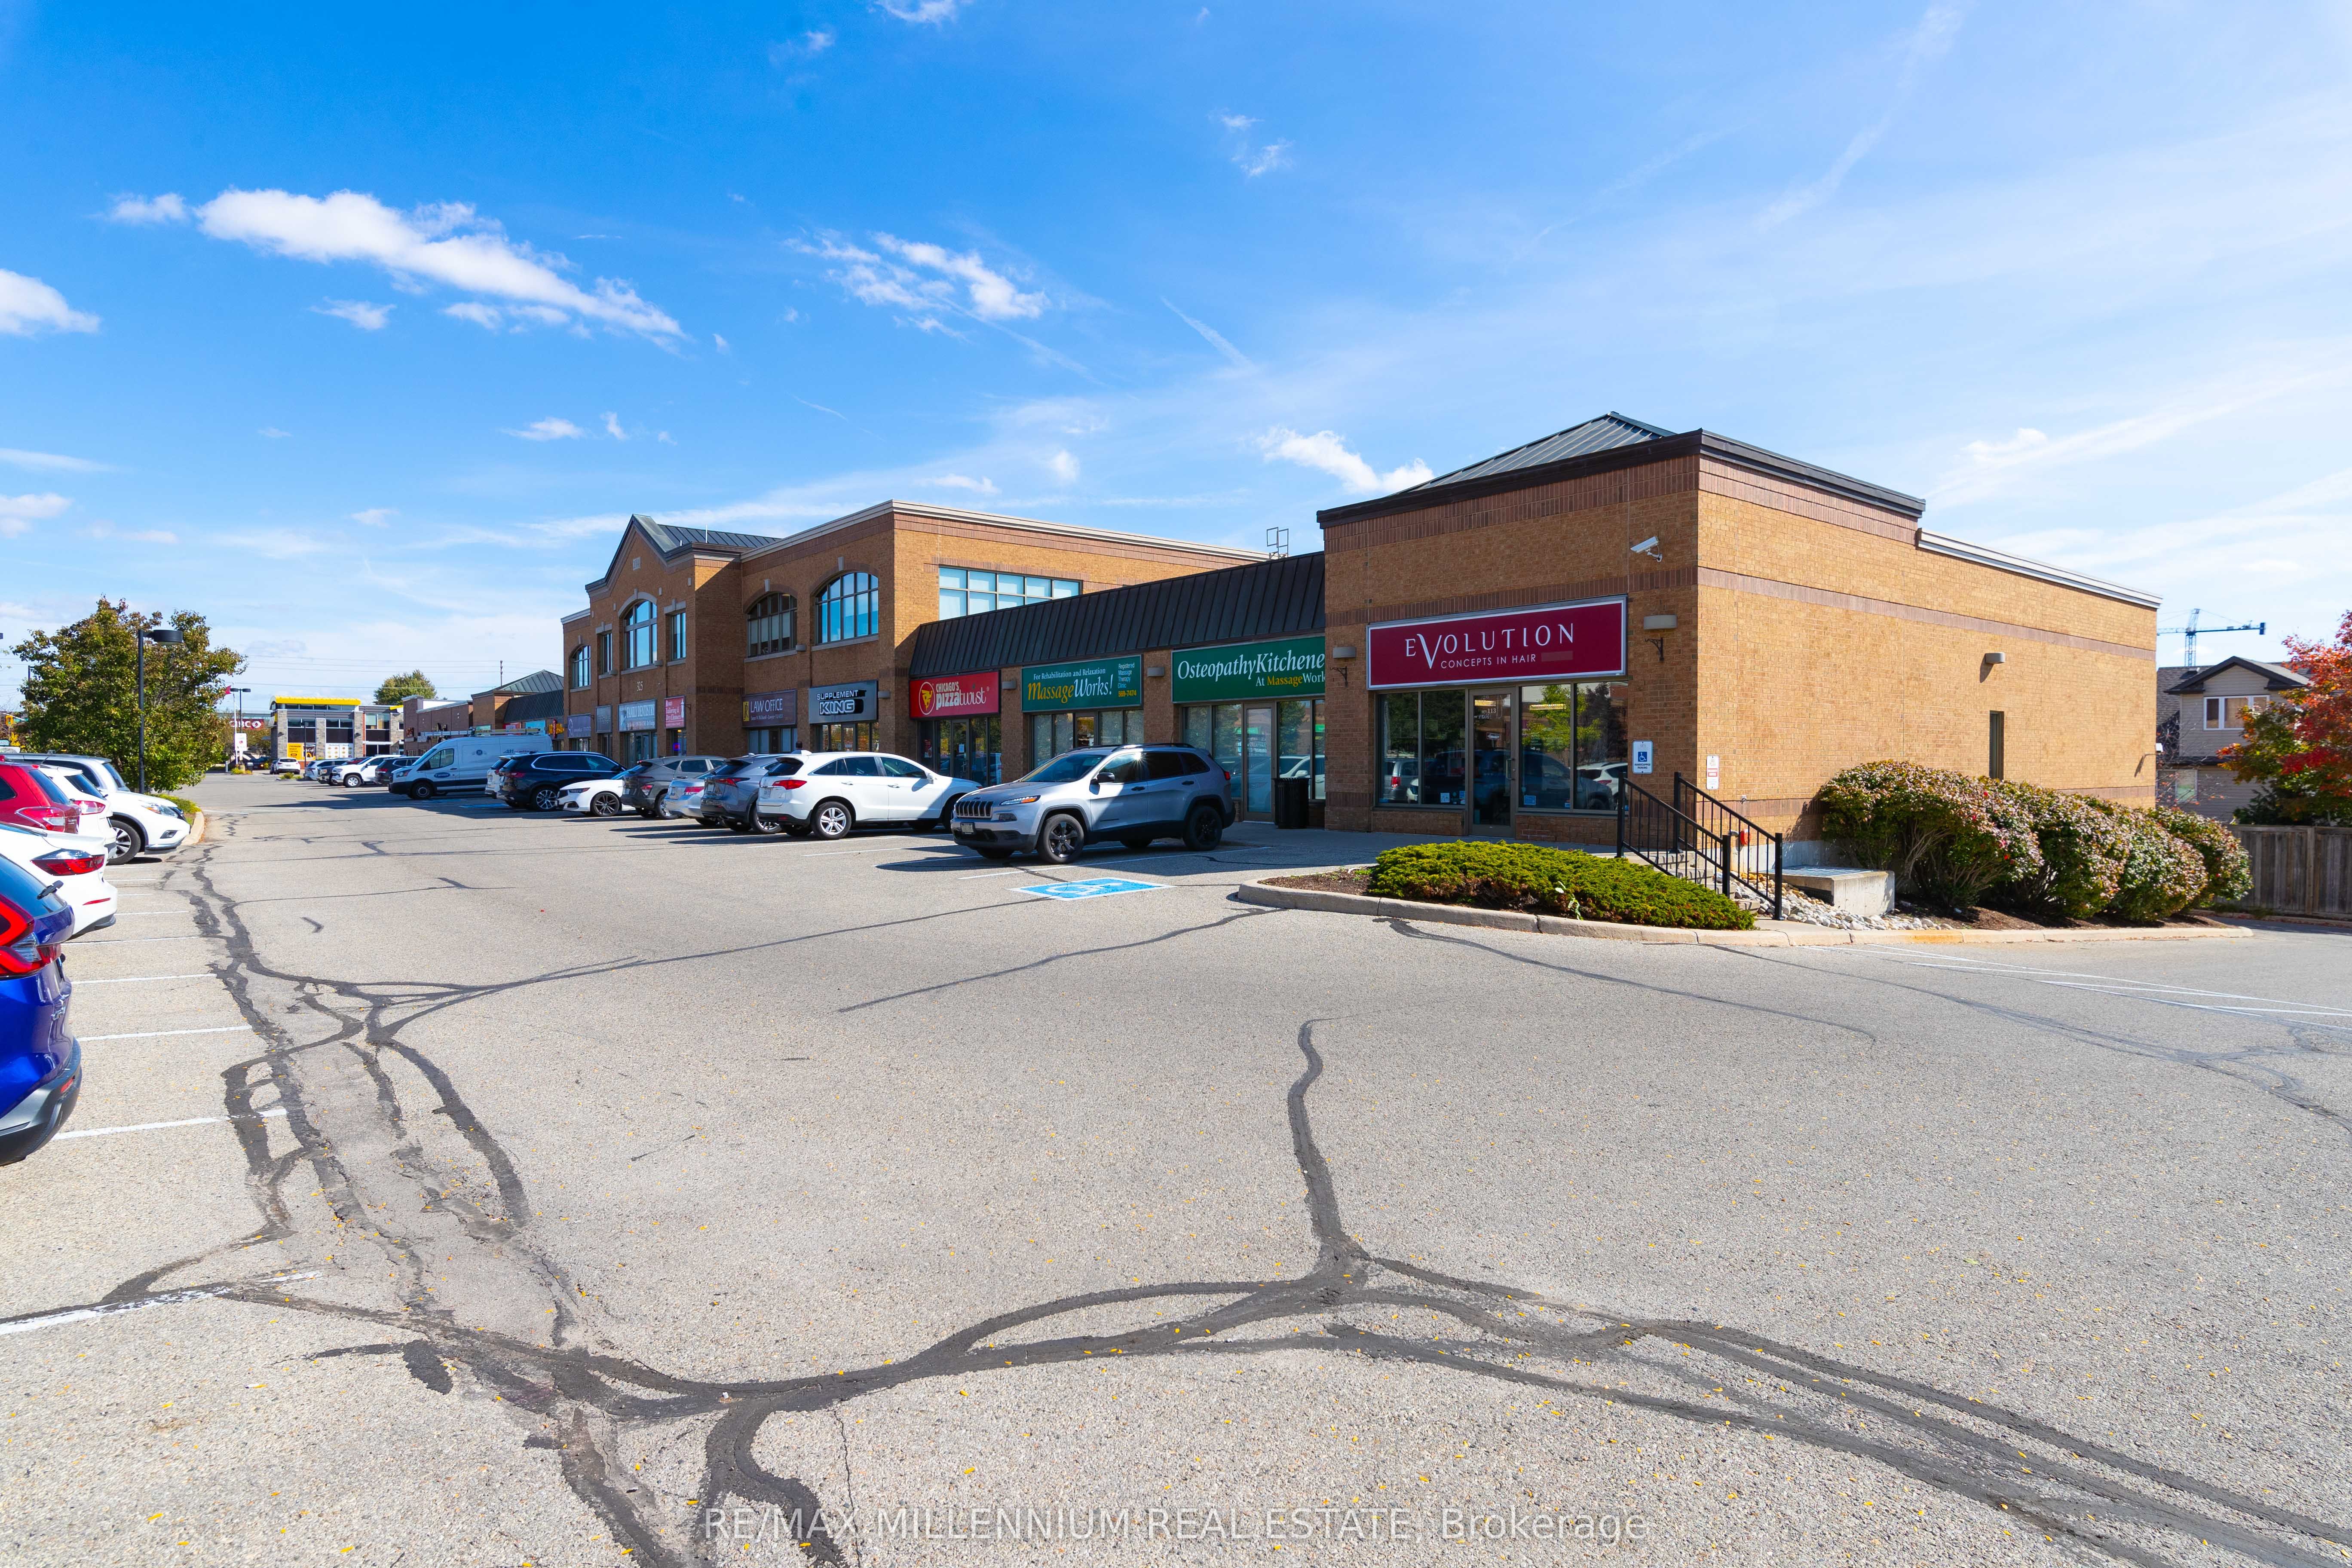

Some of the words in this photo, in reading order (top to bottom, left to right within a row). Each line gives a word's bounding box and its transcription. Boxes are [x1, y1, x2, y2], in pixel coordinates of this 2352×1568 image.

[1404, 622, 1574, 669] EVOLUTION
[1118, 662, 1135, 670] Registered
[1441, 657, 1492, 669] CONCEPTS
[1497, 655, 1507, 665] IN
[1512, 654, 1536, 664] HAIR
[1082, 667, 1106, 676] Relaxation
[936, 681, 959, 693] CHICAGO'S
[1256, 676, 1265, 686] At
[817, 689, 858, 700] SUPPLEMENT
[1028, 674, 1114, 704] MassageWorks!
[750, 700, 764, 713] LAW
[765, 698, 783, 712] OFFICE
[819, 699, 855, 715] KING
